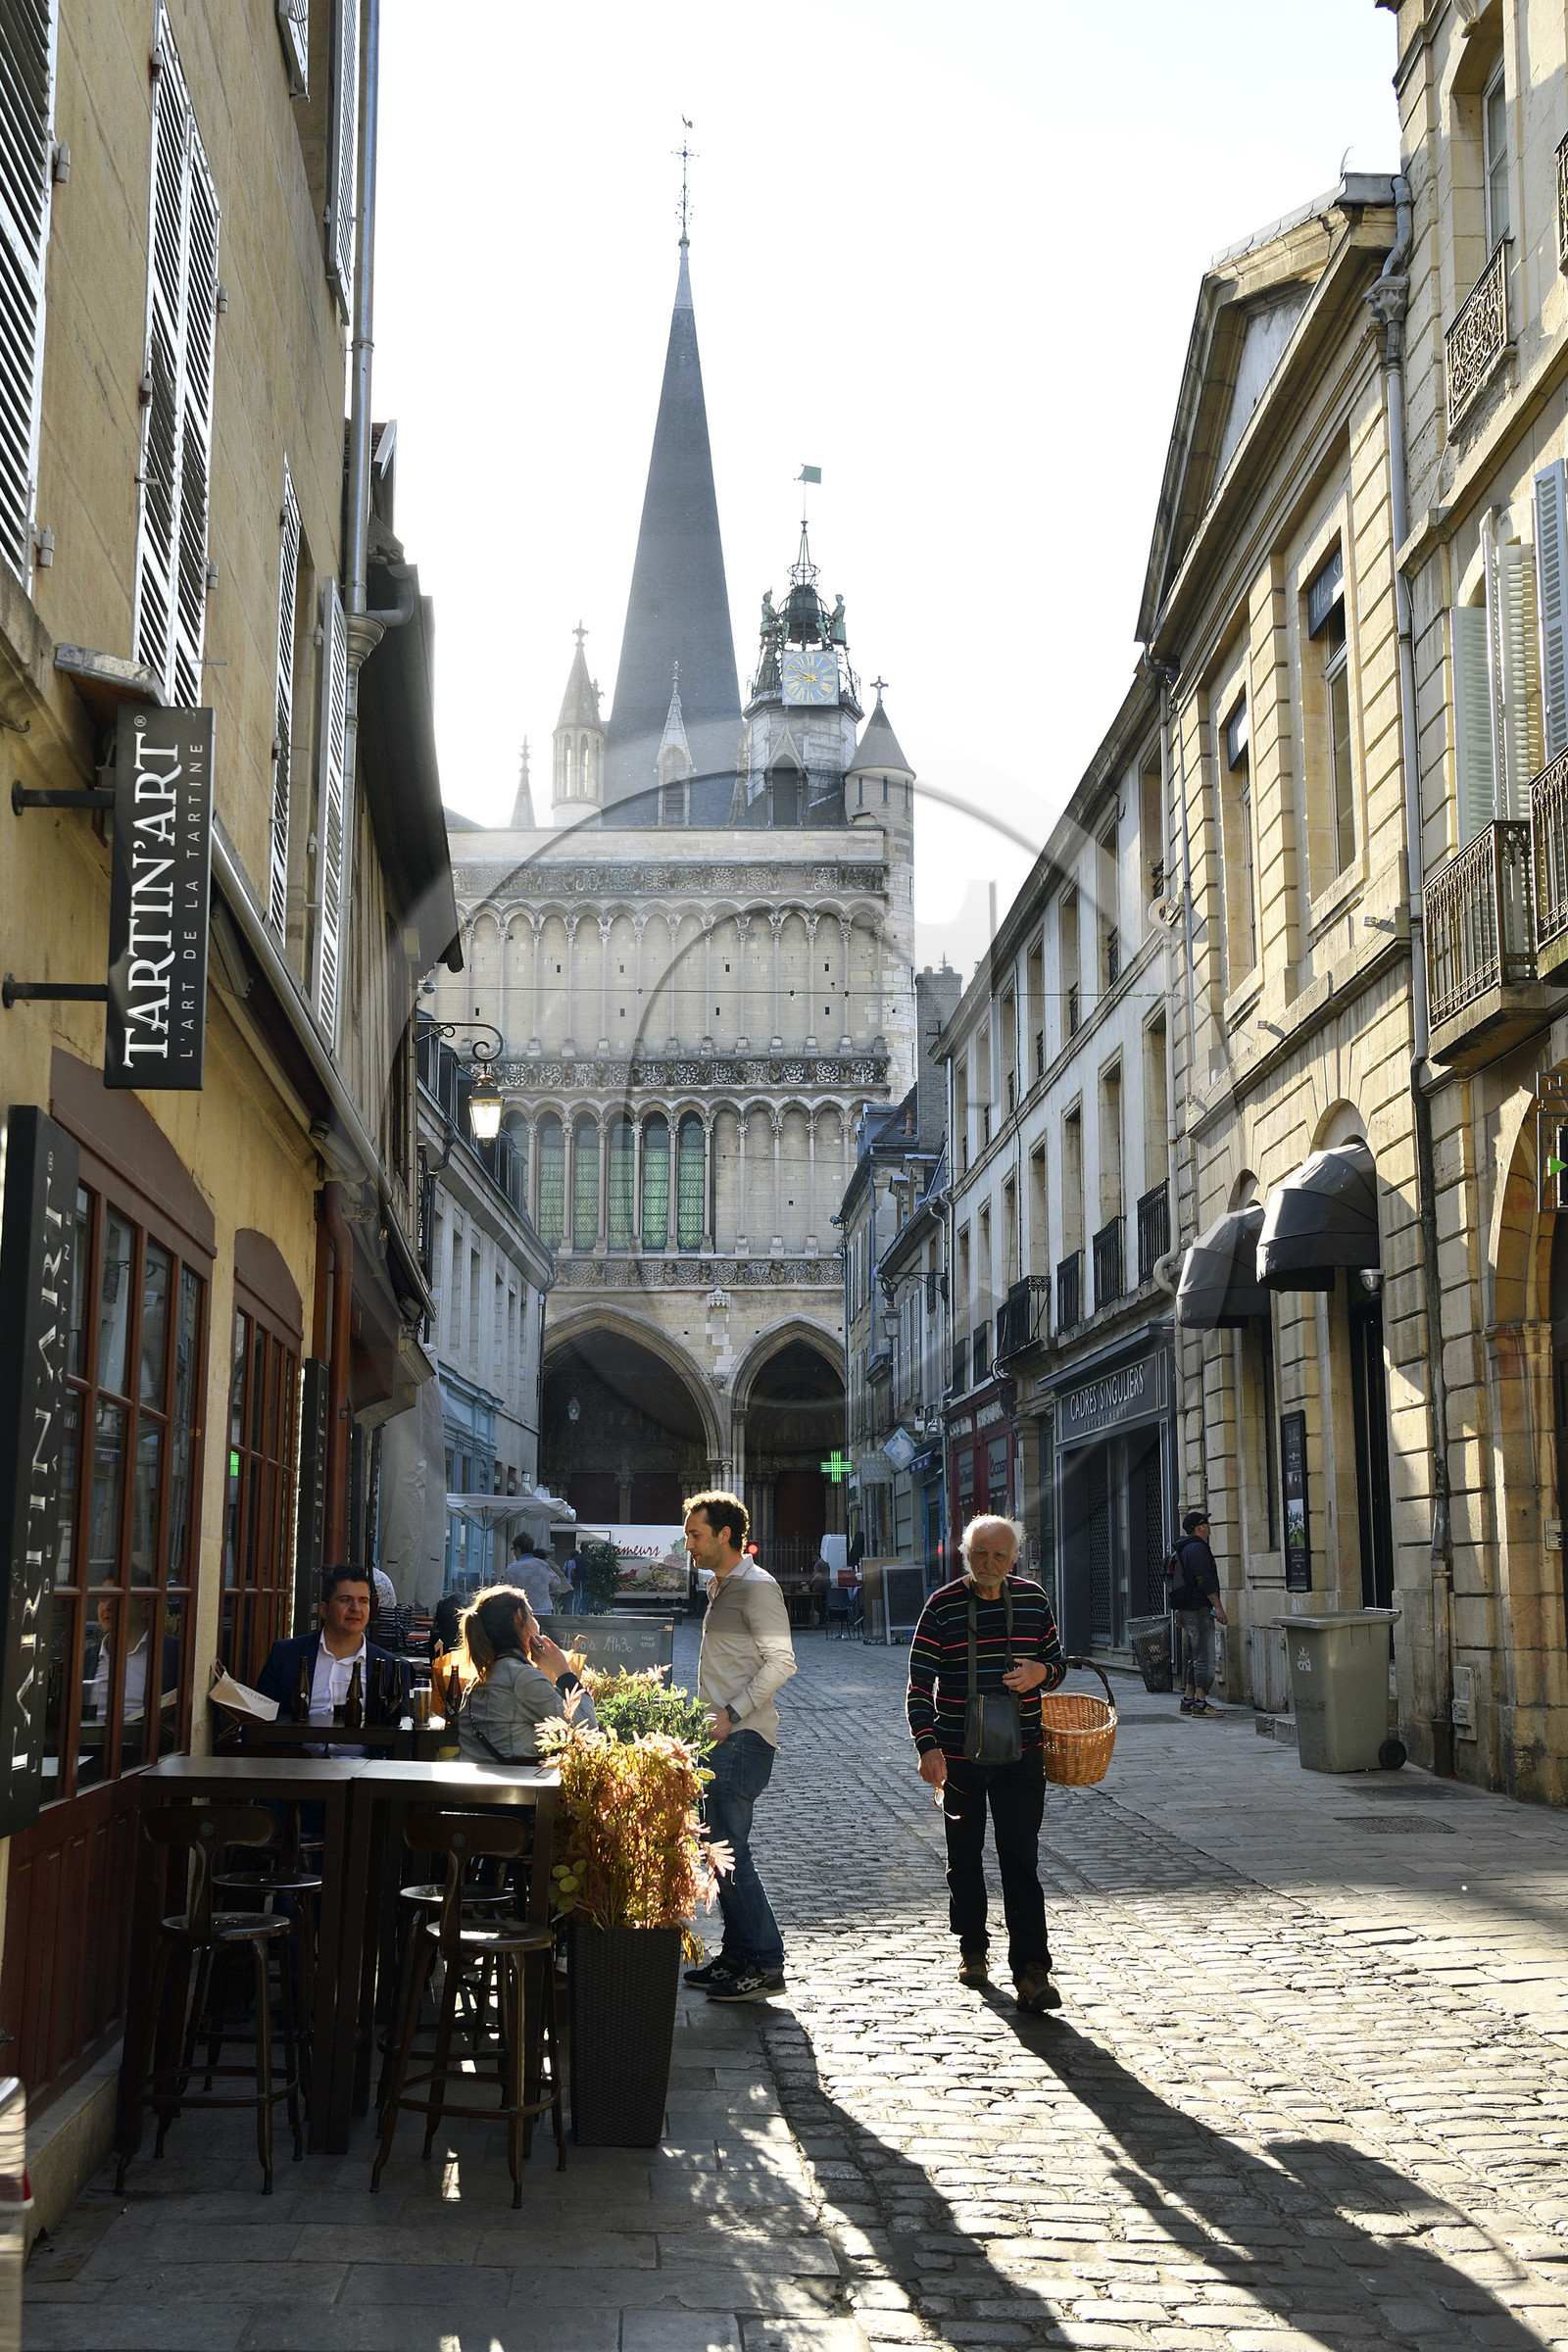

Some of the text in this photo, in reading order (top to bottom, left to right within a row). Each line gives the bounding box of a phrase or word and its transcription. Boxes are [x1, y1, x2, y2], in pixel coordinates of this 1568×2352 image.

[180, 744, 204, 1058] L'ART DE LA TARTINE
[1070, 1364, 1144, 1421] CADRES SINGULIERS
[613, 1540, 662, 1556] imeurs
